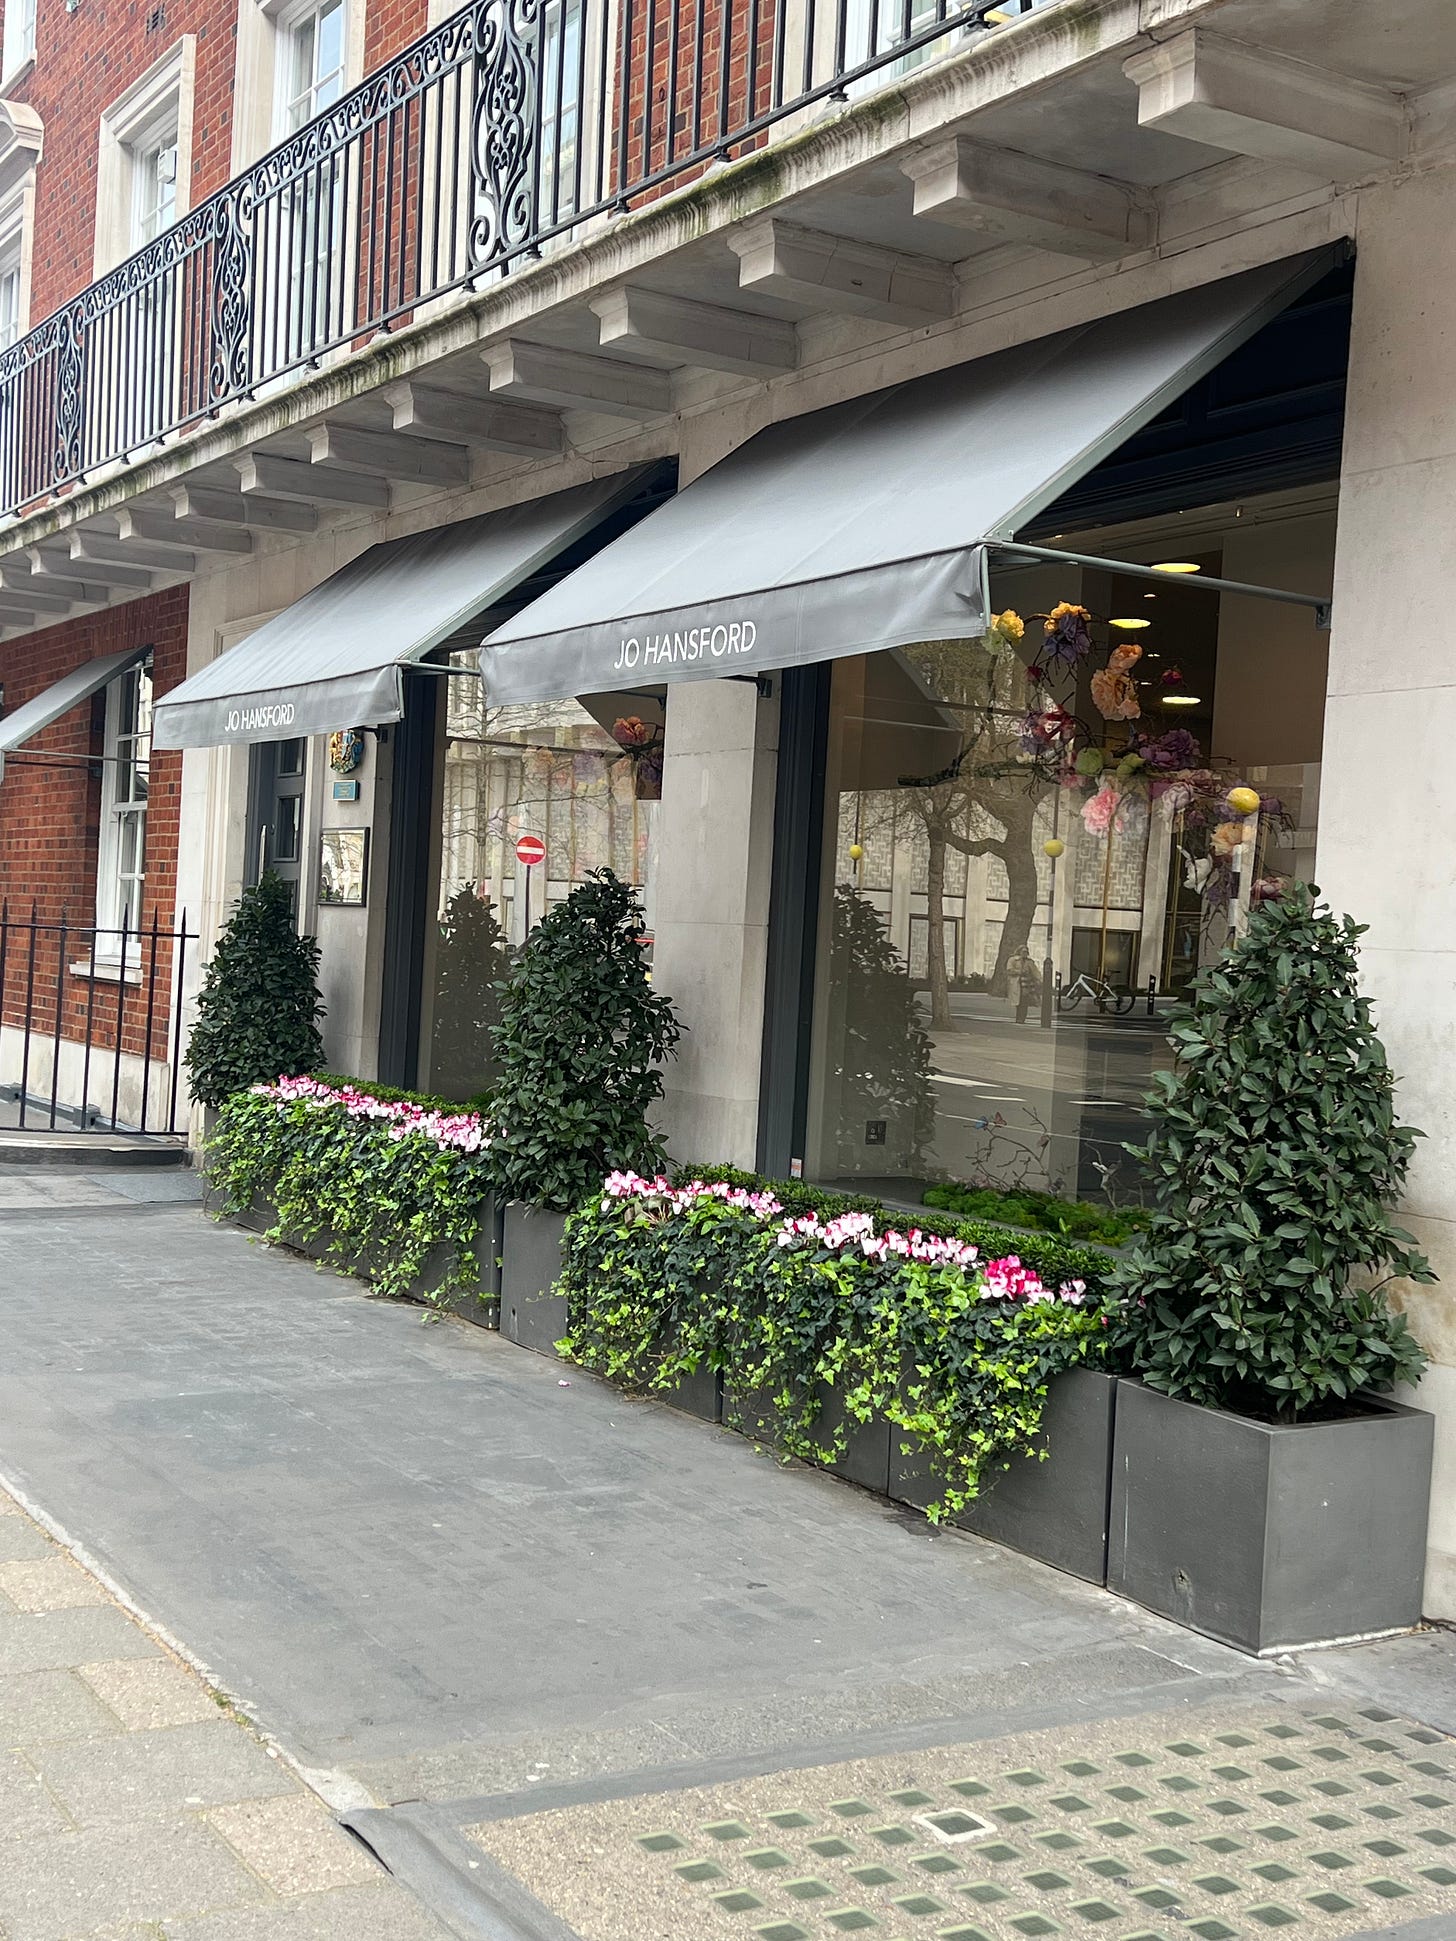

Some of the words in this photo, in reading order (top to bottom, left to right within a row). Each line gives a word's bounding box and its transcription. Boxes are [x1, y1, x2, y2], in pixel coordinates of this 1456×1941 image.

[613, 638, 640, 669] JO
[643, 620, 757, 665] HANSFORD
[224, 710, 240, 732] JO
[240, 703, 295, 730] HANSFORD
